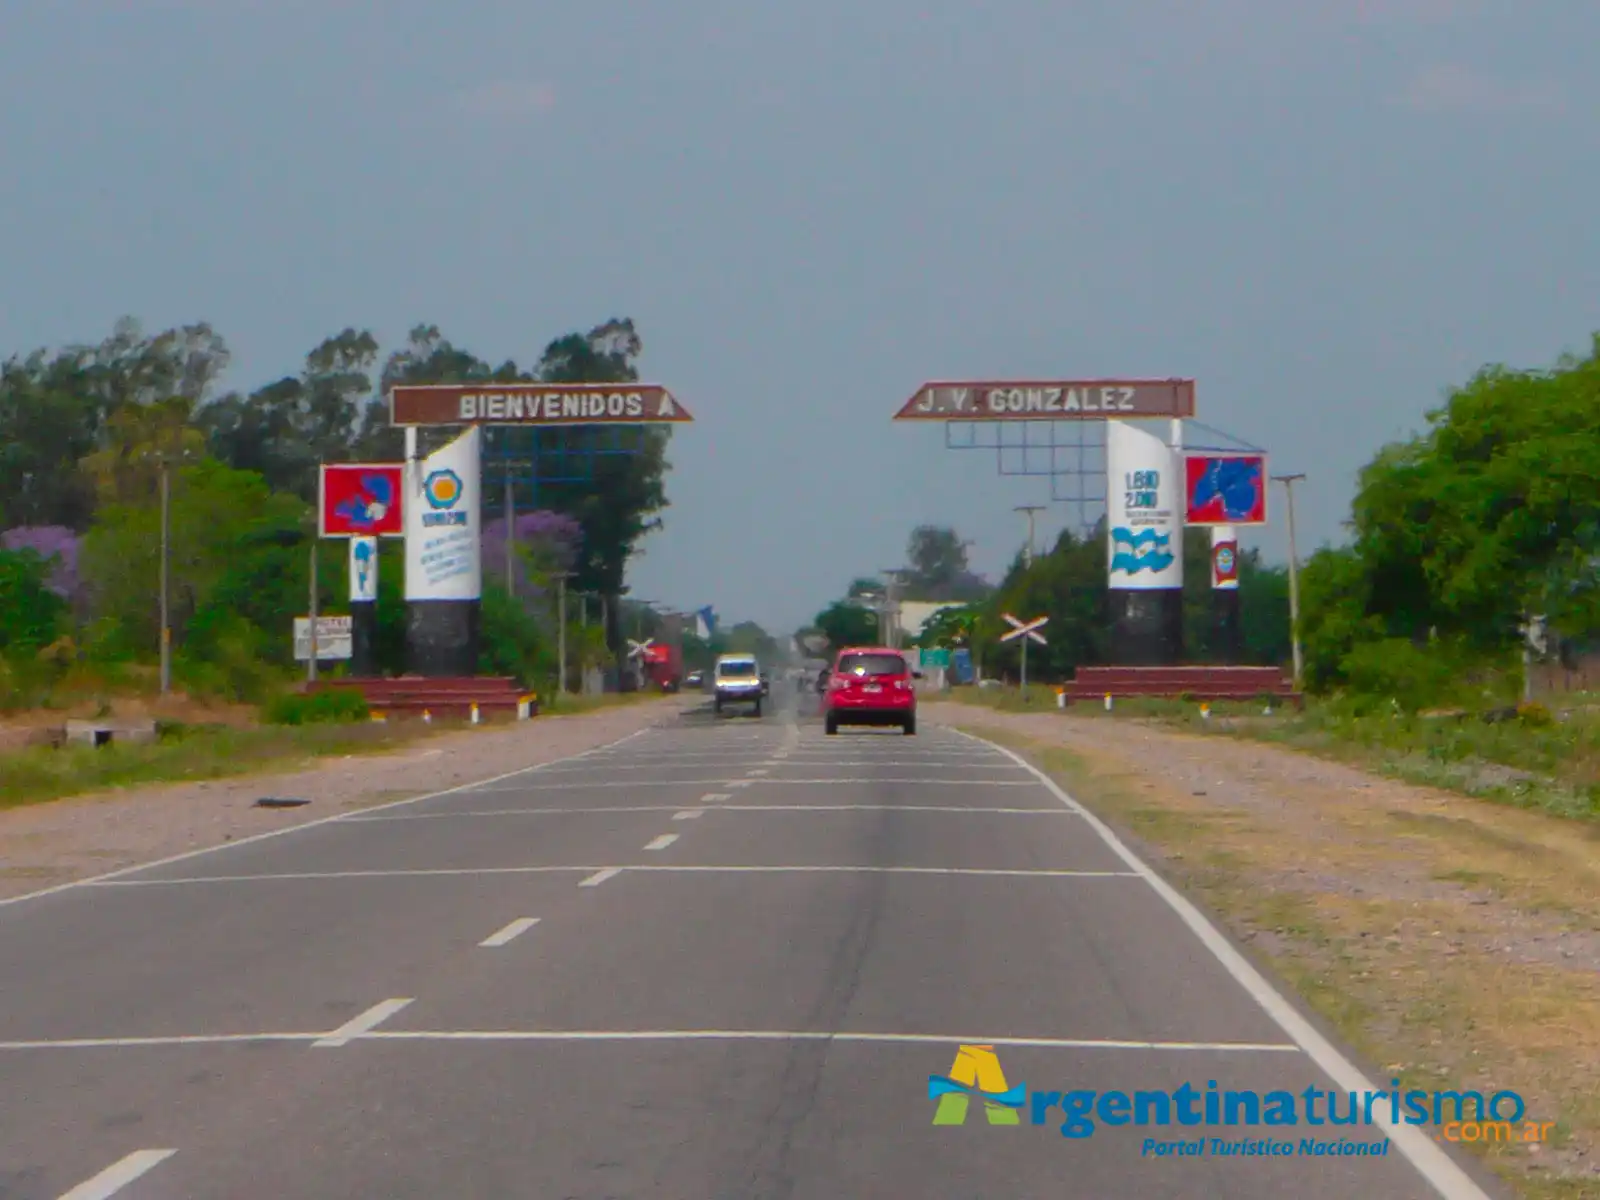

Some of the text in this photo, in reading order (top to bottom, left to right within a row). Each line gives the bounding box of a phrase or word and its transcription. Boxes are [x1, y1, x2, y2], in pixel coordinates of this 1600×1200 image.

[459, 392, 676, 419] BIENVENIDOS A
[988, 387, 1135, 412] GONZALEZ
